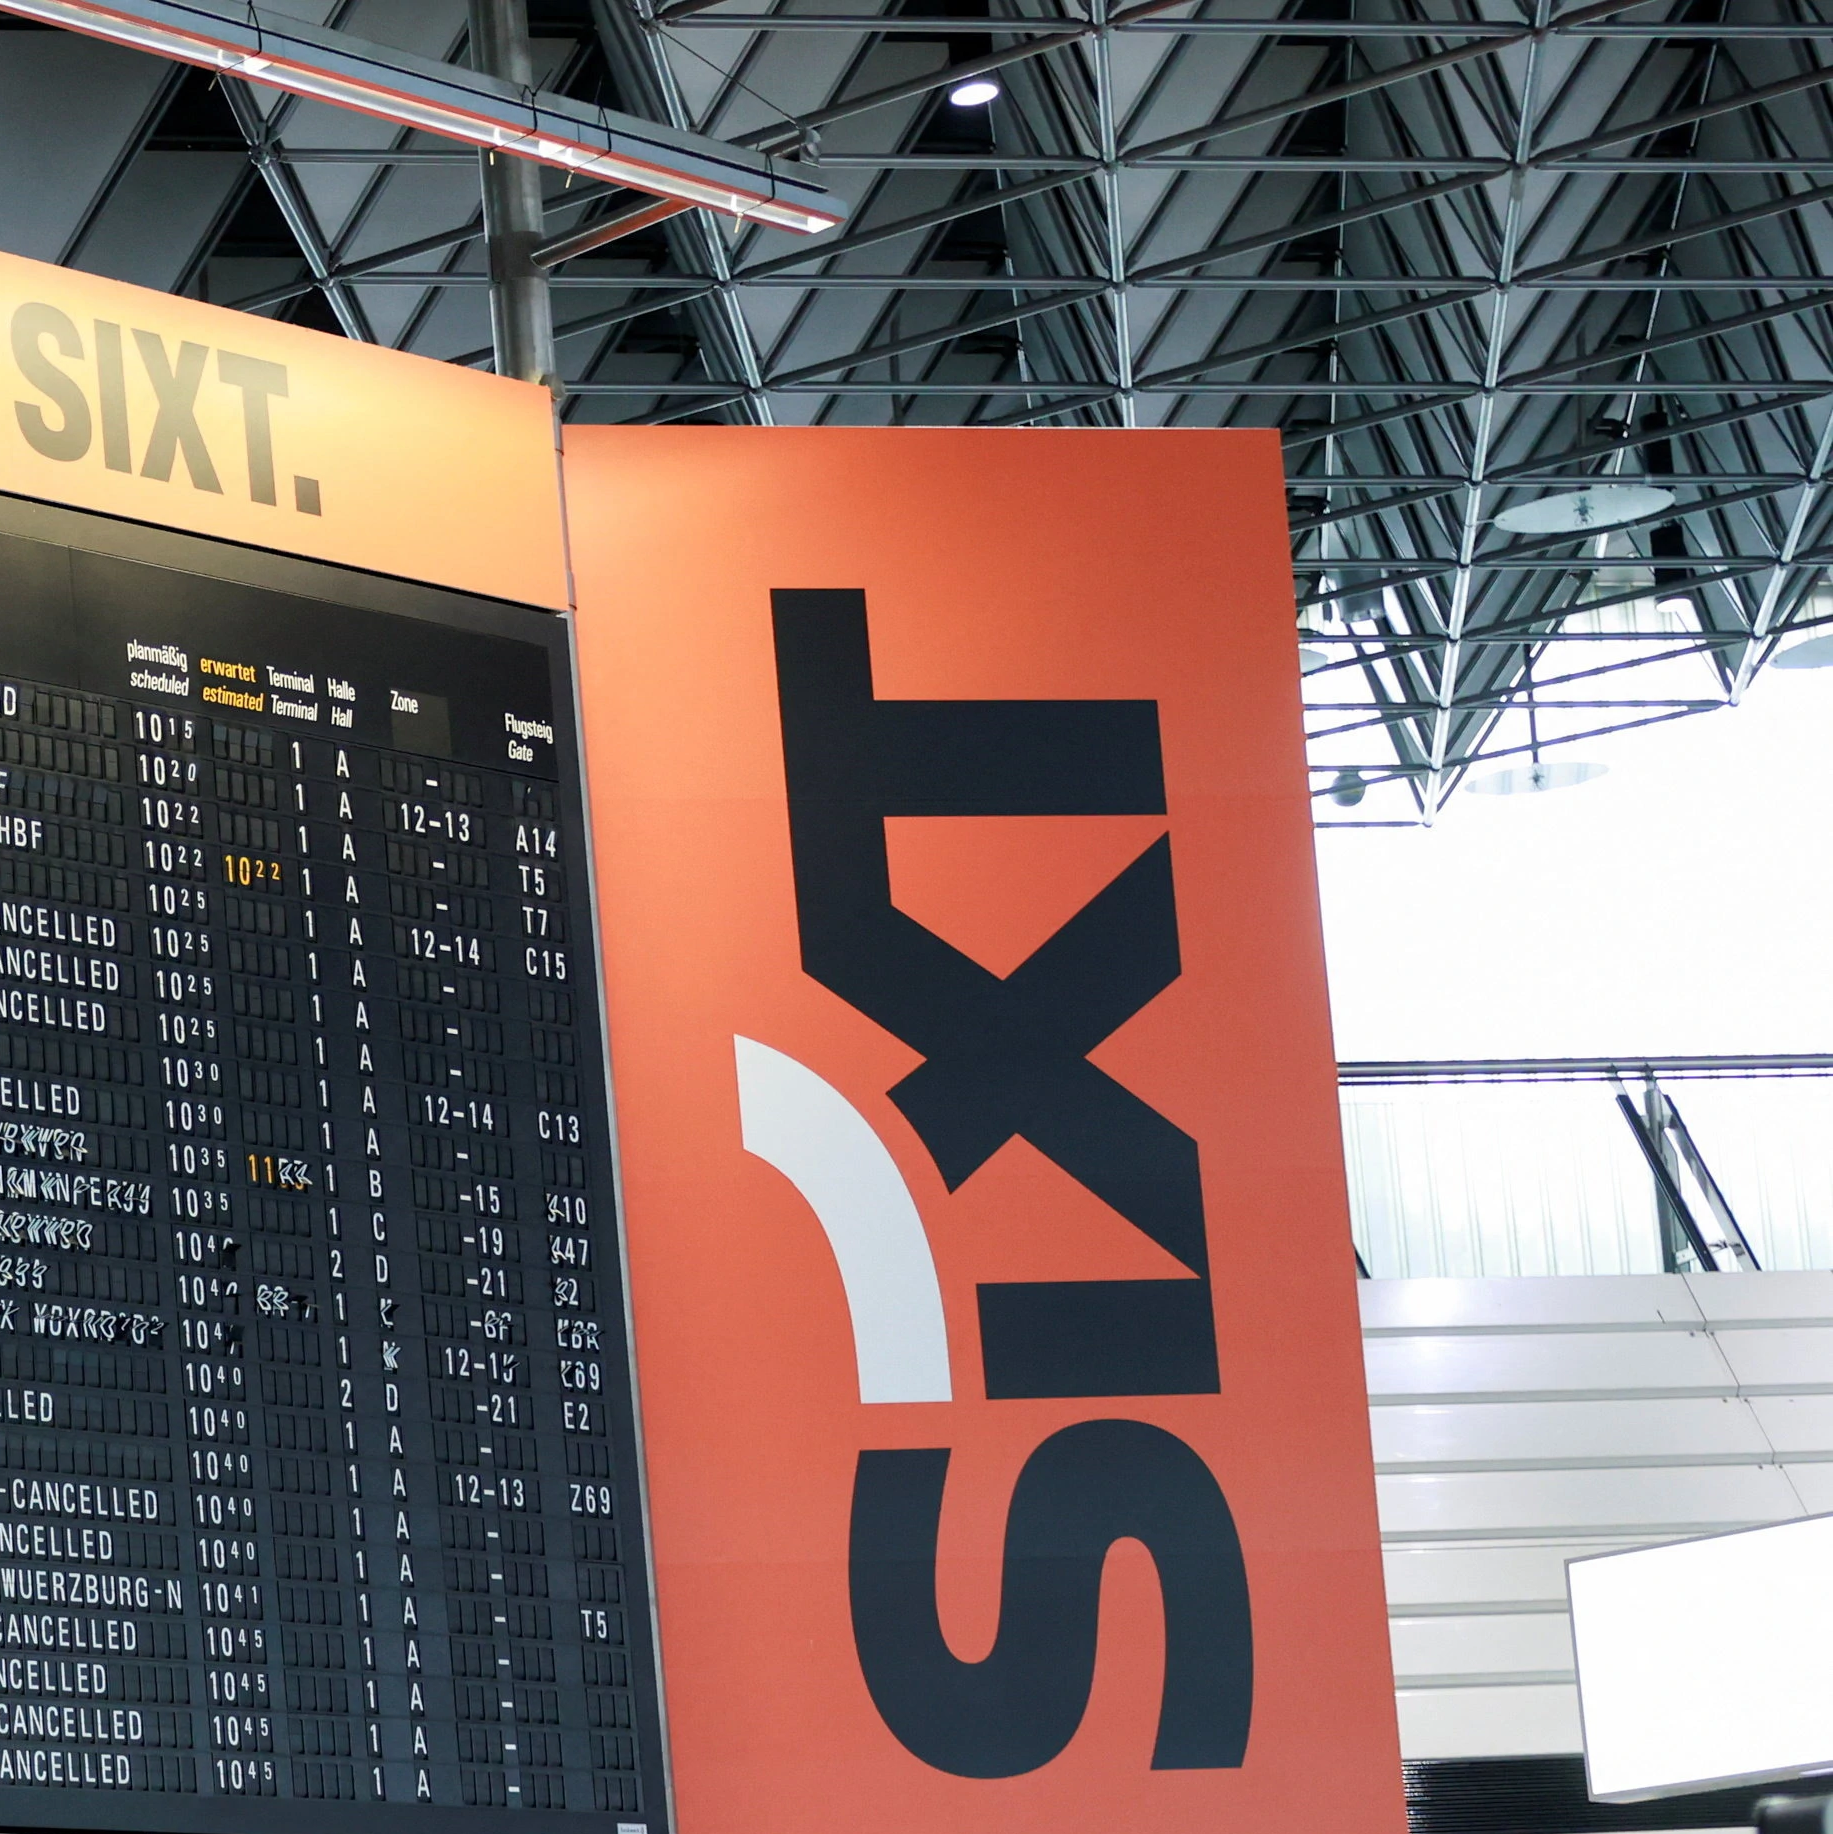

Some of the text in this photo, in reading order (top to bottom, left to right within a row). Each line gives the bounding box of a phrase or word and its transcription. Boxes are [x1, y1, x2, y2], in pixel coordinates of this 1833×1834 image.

[10, 301, 322, 517] SIXT.
[127, 639, 187, 672] planmäßig
[131, 669, 189, 696] scheduled
[201, 658, 255, 682] erwartet
[267, 666, 314, 693] Terminal
[203, 684, 263, 711] estimated
[328, 678, 355, 701] Halle
[391, 690, 418, 713] Zone
[271, 694, 317, 721] Terminal
[332, 706, 352, 728] Hall
[505, 713, 553, 742] Flugsteig
[509, 741, 533, 761] Gate
[527, 948, 565, 979] C15
[770, 588, 1254, 1780] SIXT
[571, 1485, 609, 1513] Z69
